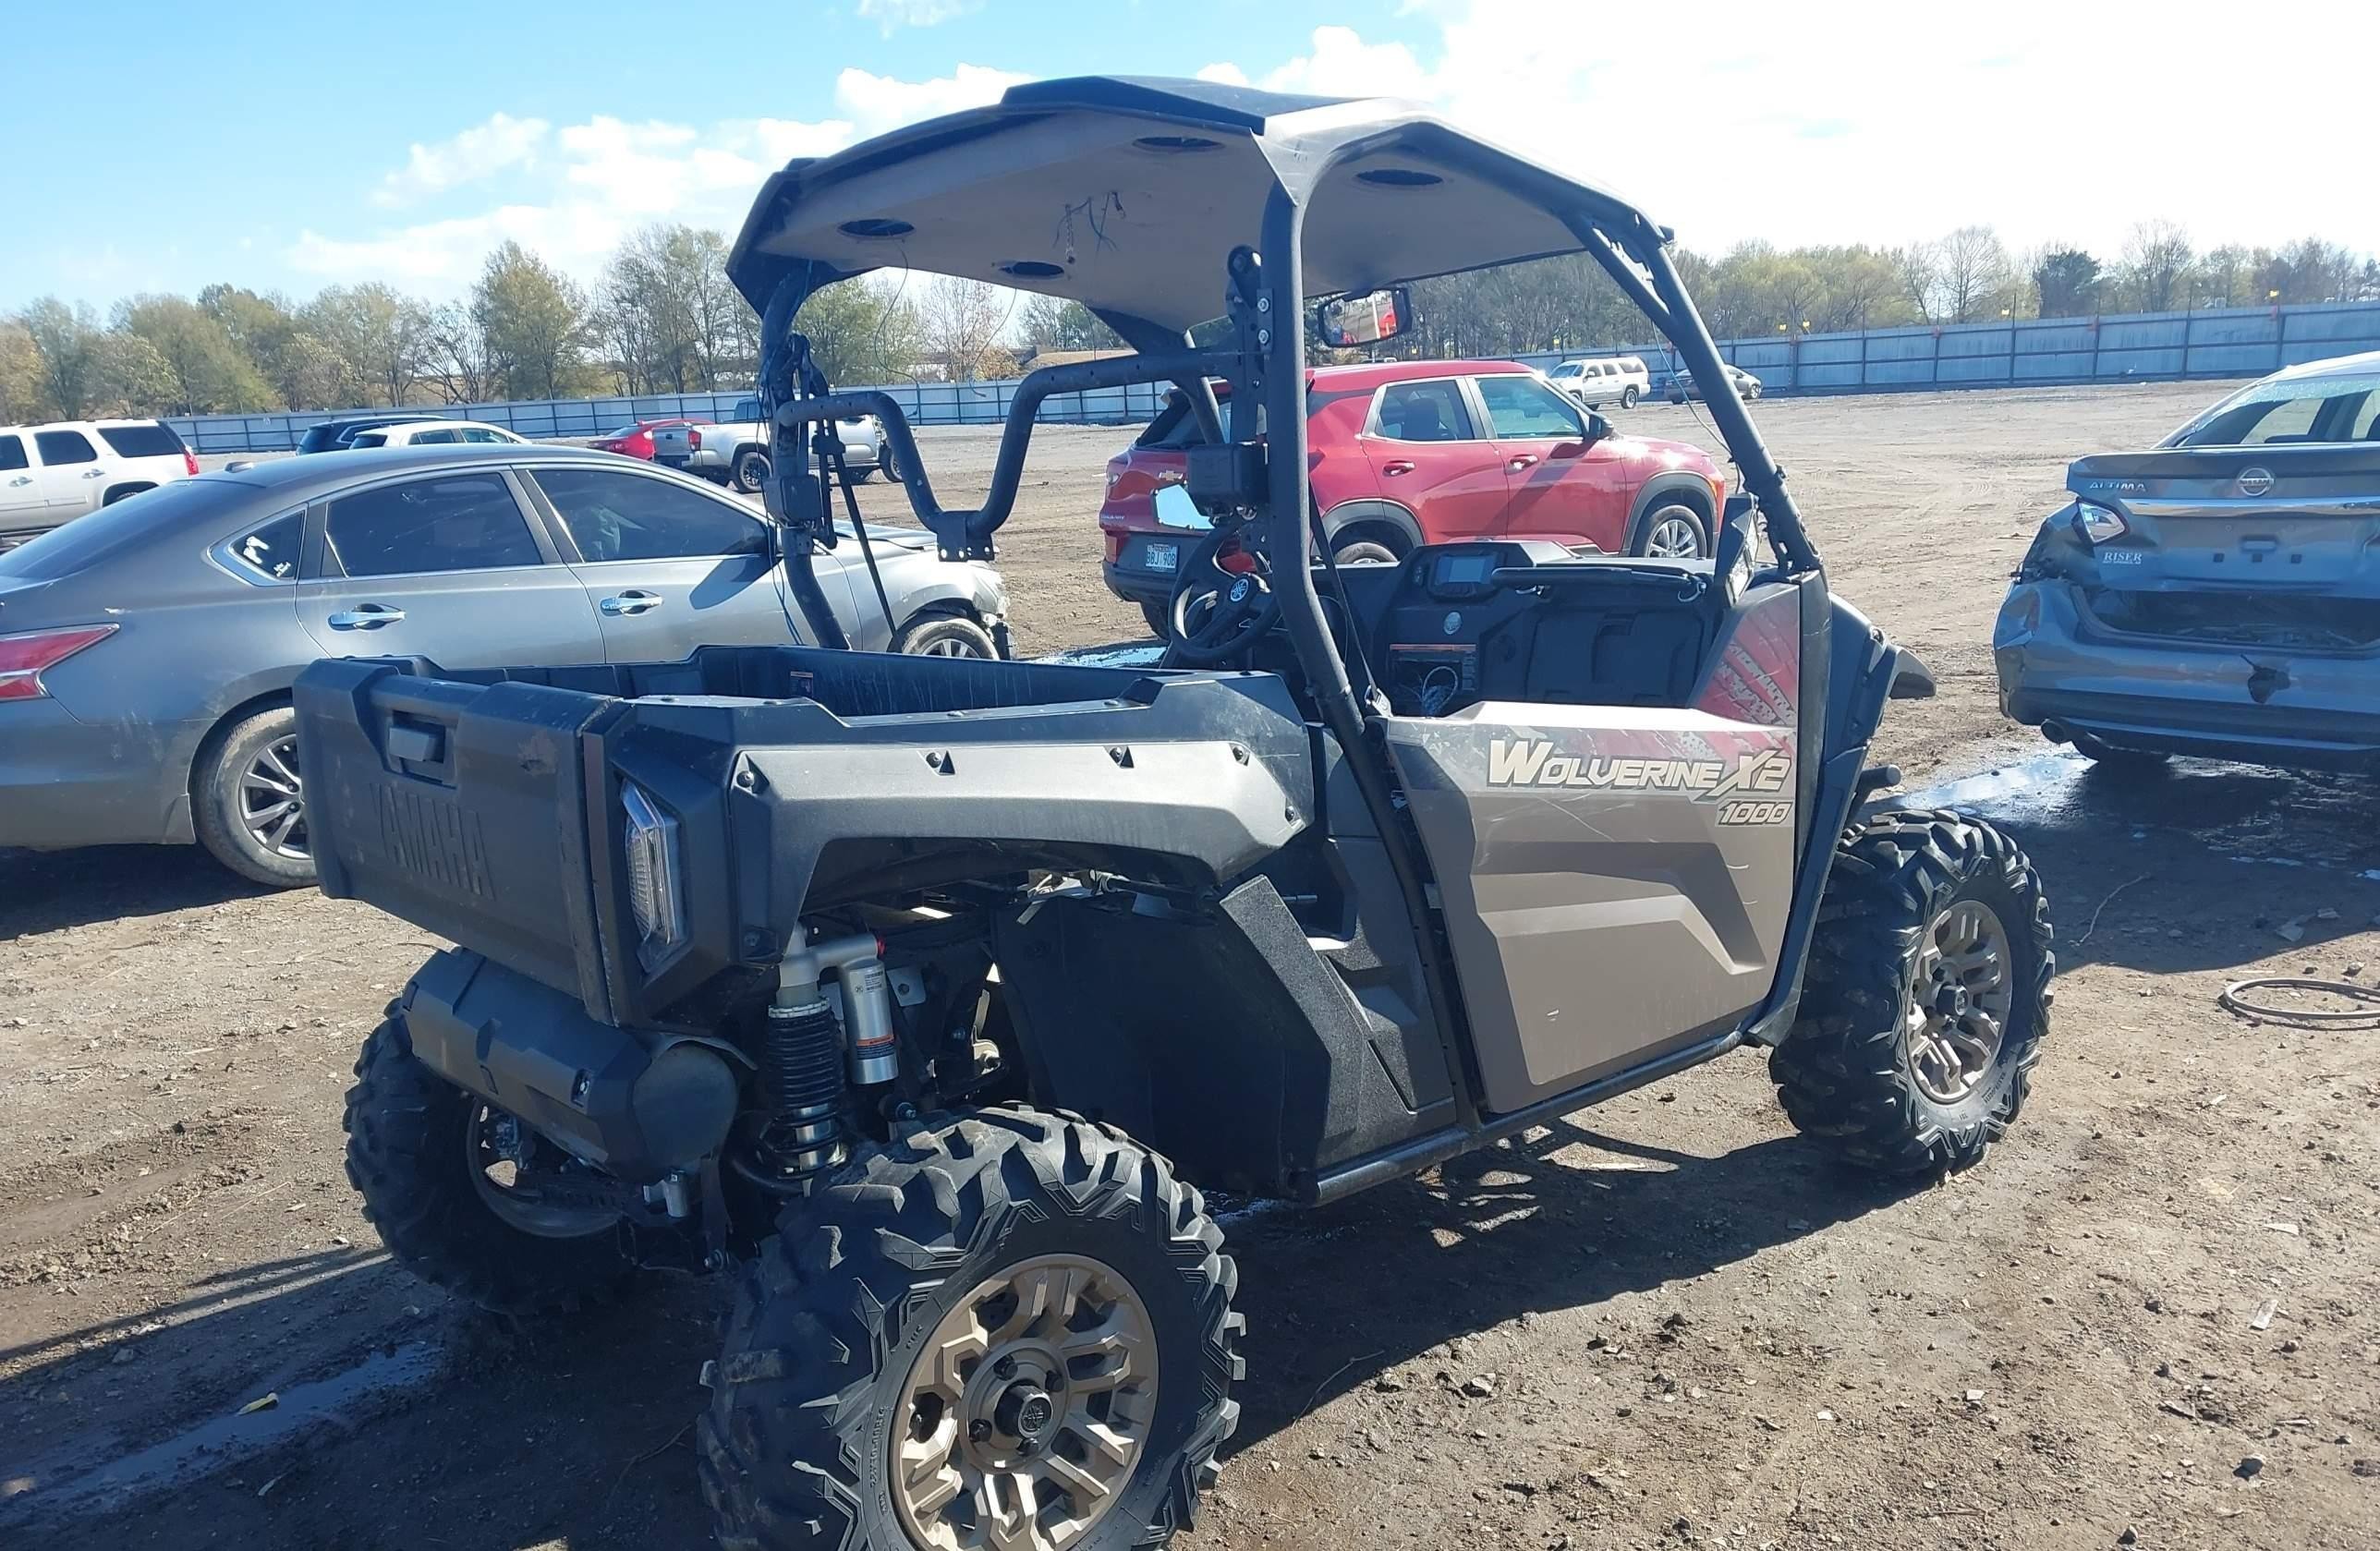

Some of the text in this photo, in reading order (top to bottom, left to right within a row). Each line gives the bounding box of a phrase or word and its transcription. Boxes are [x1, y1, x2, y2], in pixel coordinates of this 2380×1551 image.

[2089, 481, 2146, 492] ALTIMA
[2104, 551, 2143, 561] RISER
[1488, 738, 1792, 801] WOLVERINE X2
[1718, 800, 1792, 825] 1000
[370, 783, 496, 902] YAMAHA
